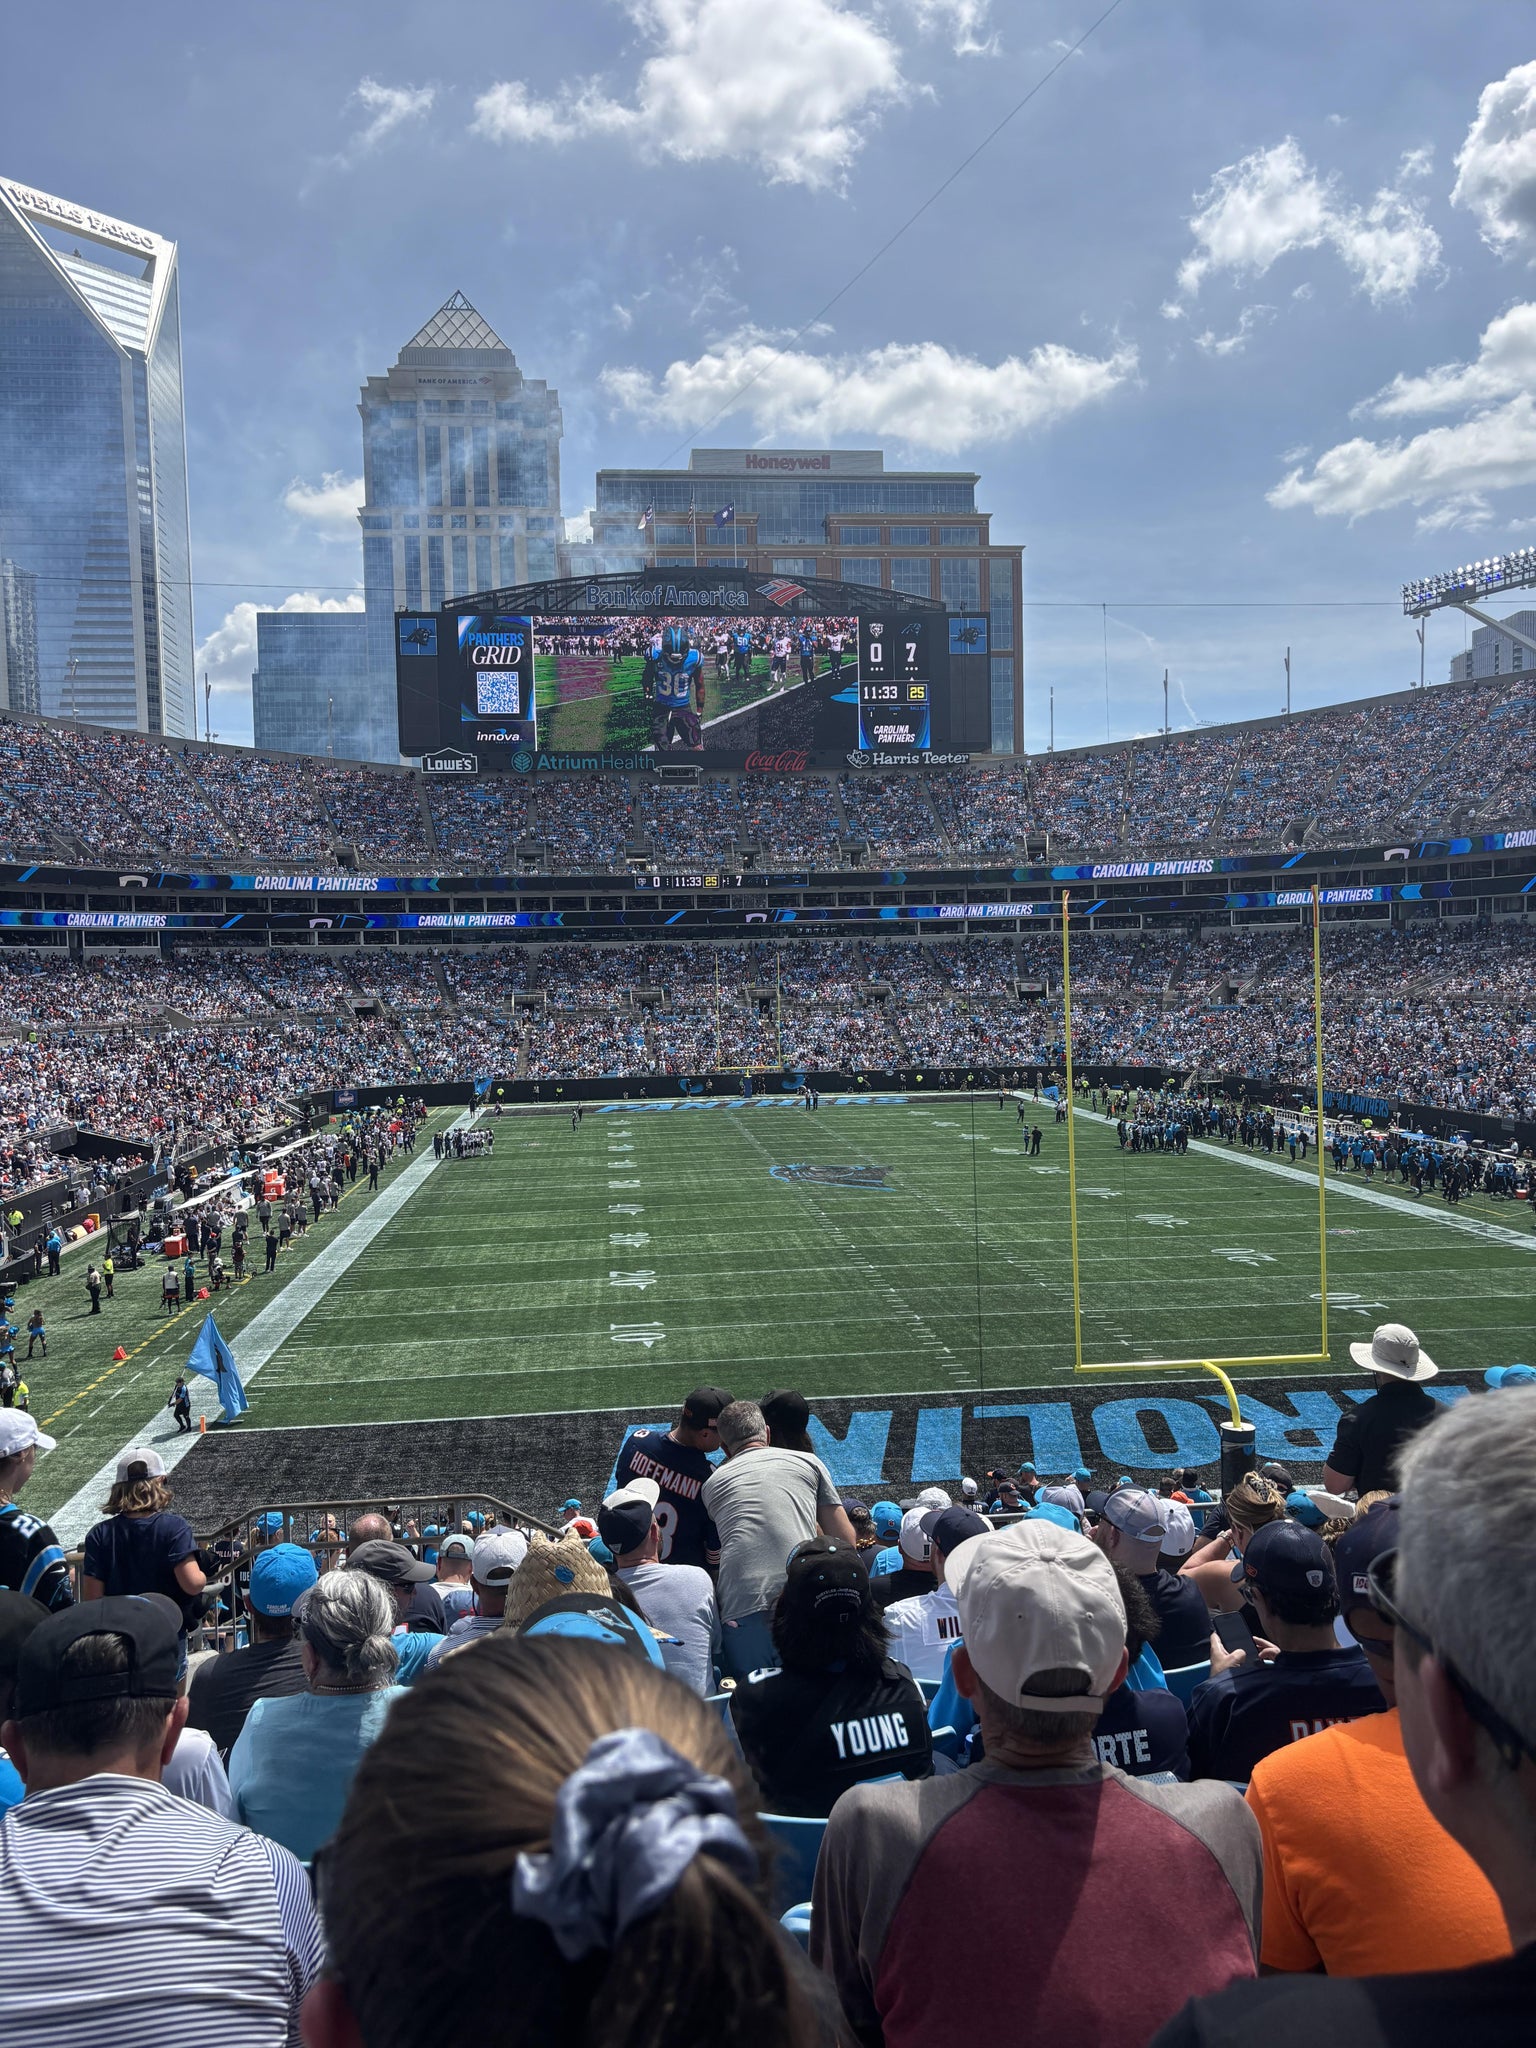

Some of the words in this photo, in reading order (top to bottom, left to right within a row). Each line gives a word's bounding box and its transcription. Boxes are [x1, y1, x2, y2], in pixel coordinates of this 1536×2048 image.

[8, 184, 83, 224] WELLS
[87, 214, 154, 250] FARGO
[745, 454, 831, 471] Honeywell
[586, 585, 640, 606] Bank
[640, 585, 663, 606] of
[664, 585, 749, 606] America
[468, 632, 525, 647] PANTHERS
[472, 645, 522, 665] GRID
[870, 643, 882, 662] 0
[905, 642, 917, 662] 7
[656, 670, 689, 698] 30
[863, 686, 898, 699] 11:33
[909, 686, 925, 699] 25
[873, 725, 910, 734] CAROLINA
[877, 733, 916, 743] PANTHERS
[427, 757, 472, 771] LOWE'S
[537, 754, 598, 769] Atrium
[601, 754, 655, 769] Health
[872, 752, 920, 765] Harris
[921, 751, 969, 765] Teeter
[1092, 862, 1151, 880] CAROLINA
[1152, 859, 1214, 876] PANTHERS
[254, 876, 313, 890] CAROLINA
[317, 877, 378, 891] PANTHERS
[652, 876, 660, 887] 0
[675, 876, 701, 887] 11:33
[705, 876, 717, 886] 25
[736, 875, 742, 887] 7
[1326, 888, 1374, 902] PANTHERS
[939, 905, 983, 918] CAROLINA
[986, 903, 1033, 916] PANTHERS
[67, 913, 114, 926] CAROLINA
[117, 915, 167, 927] PANTHERS
[418, 915, 466, 927] CAROLINA
[468, 914, 516, 926] PANTHERS
[1350, 1094, 1389, 1118] PANTHERS
[629, 1450, 702, 1500] HOFFMANN
[830, 1711, 909, 1759] YOUNG
